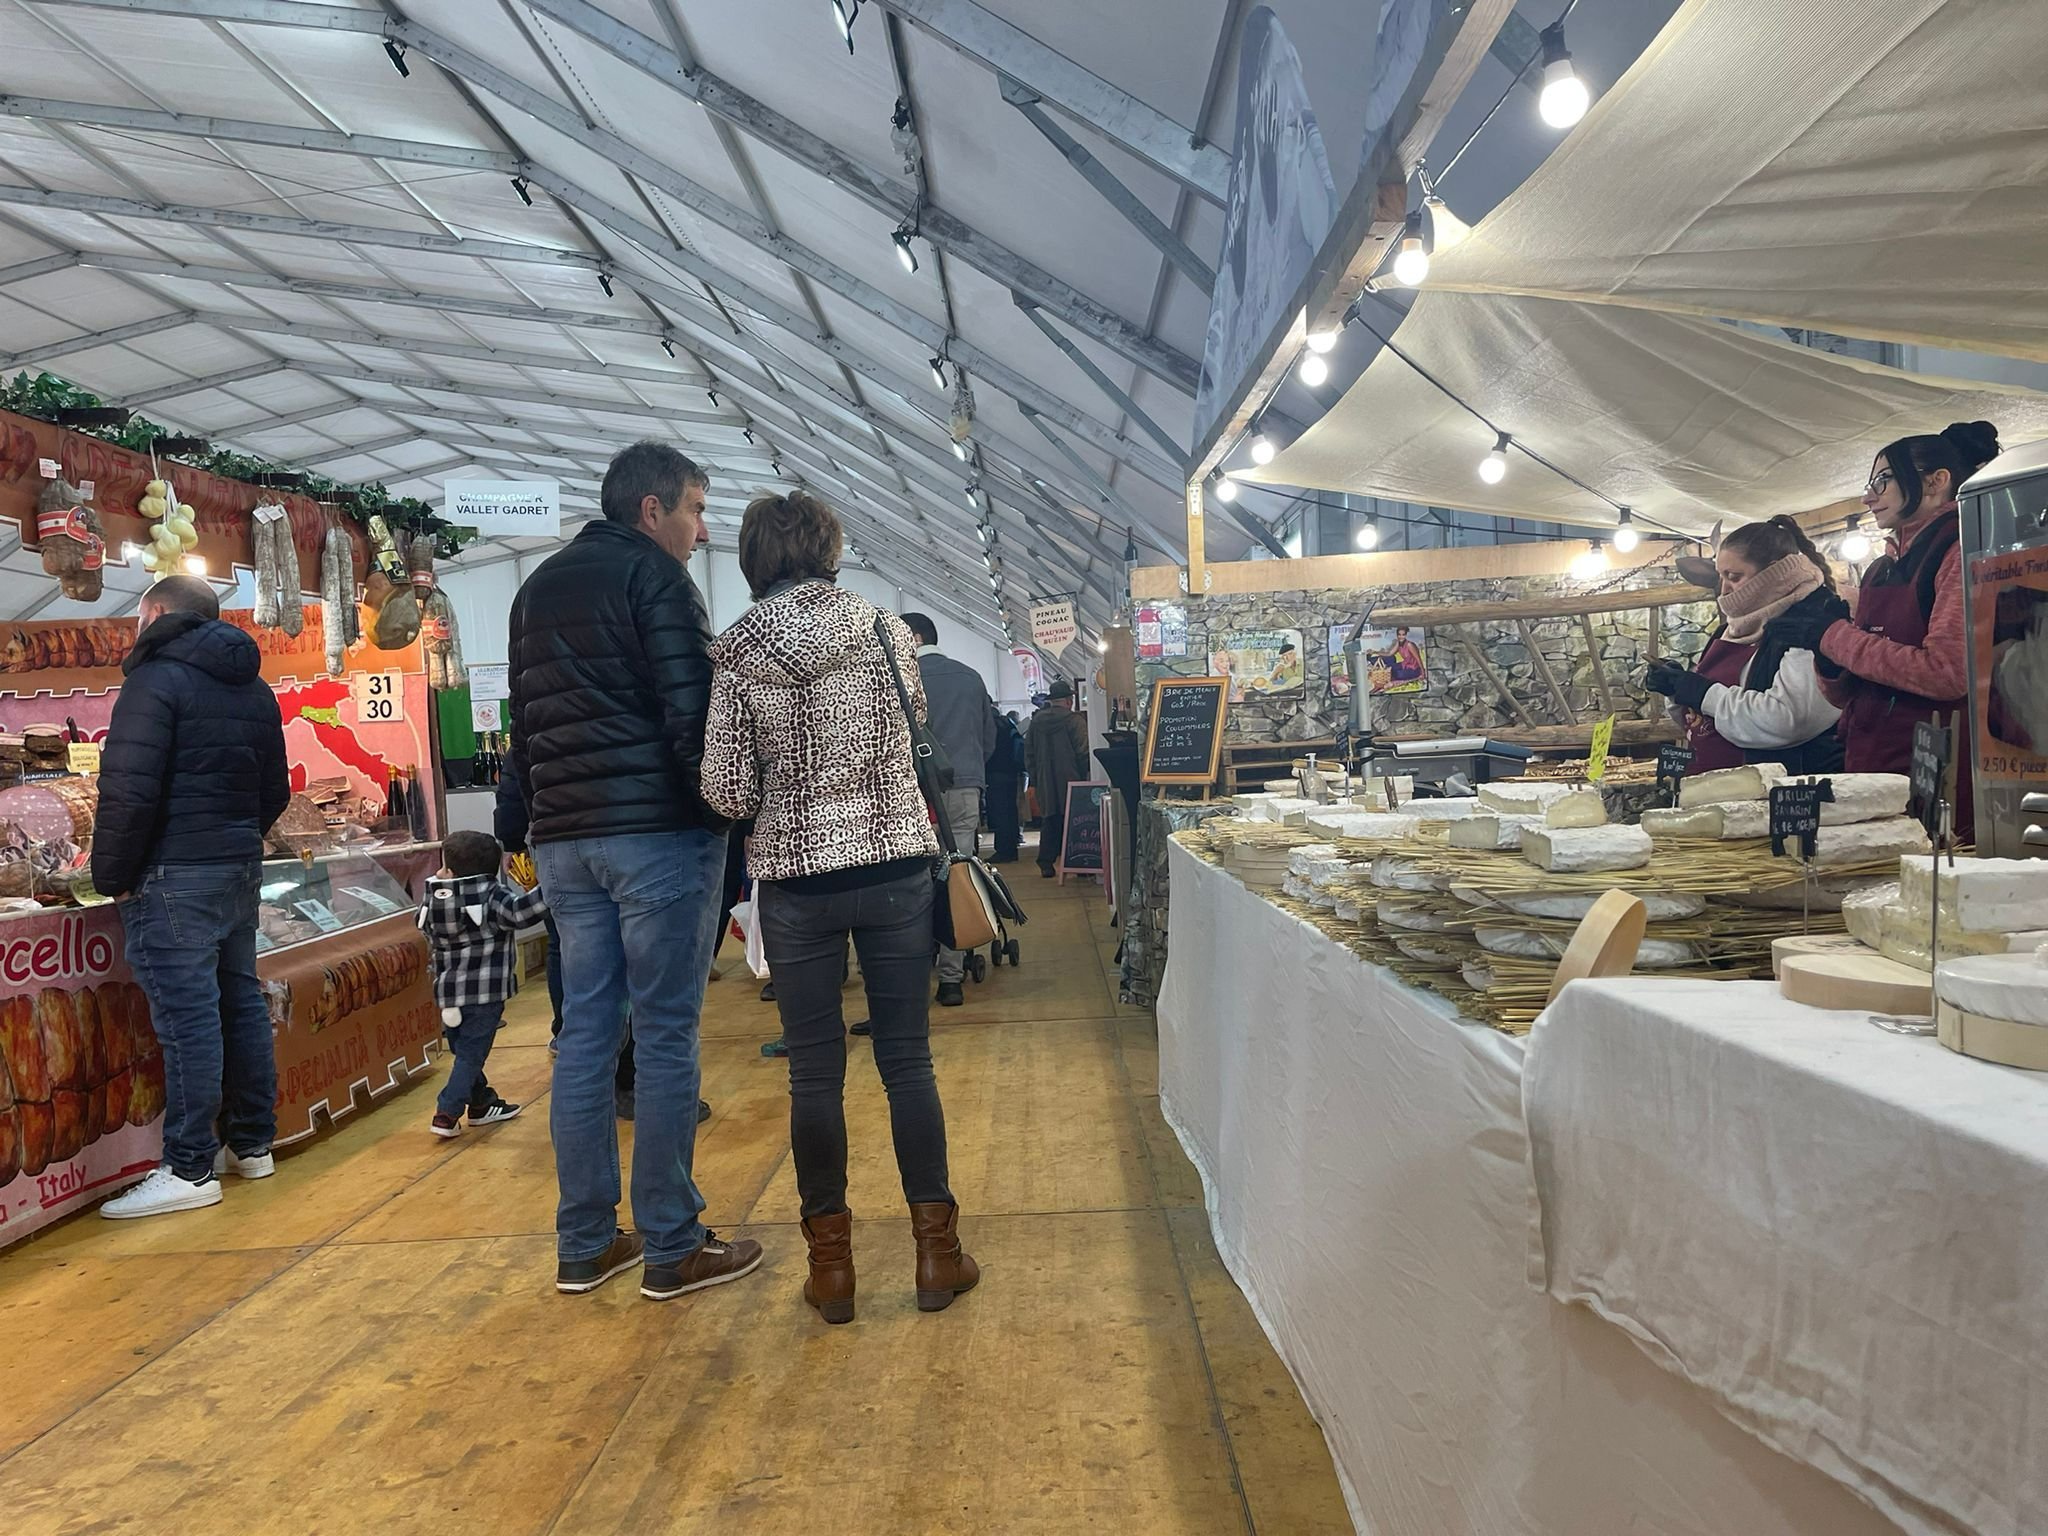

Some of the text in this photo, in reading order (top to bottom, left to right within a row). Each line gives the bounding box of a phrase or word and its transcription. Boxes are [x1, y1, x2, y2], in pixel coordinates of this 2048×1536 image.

[456, 504, 549, 515] VALLET GADRET
[1036, 608, 1067, 618] PINEAU
[1036, 616, 1069, 626] COGNAC
[1034, 626, 1074, 638] CHAUVAUD
[369, 676, 391, 695] 31
[367, 699, 392, 719] 30
[1777, 790, 1816, 802] BRILLAT
[1775, 805, 1811, 816] SAVARIN
[0, 916, 113, 982] cello
[36, 1161, 86, 1204] Italy
